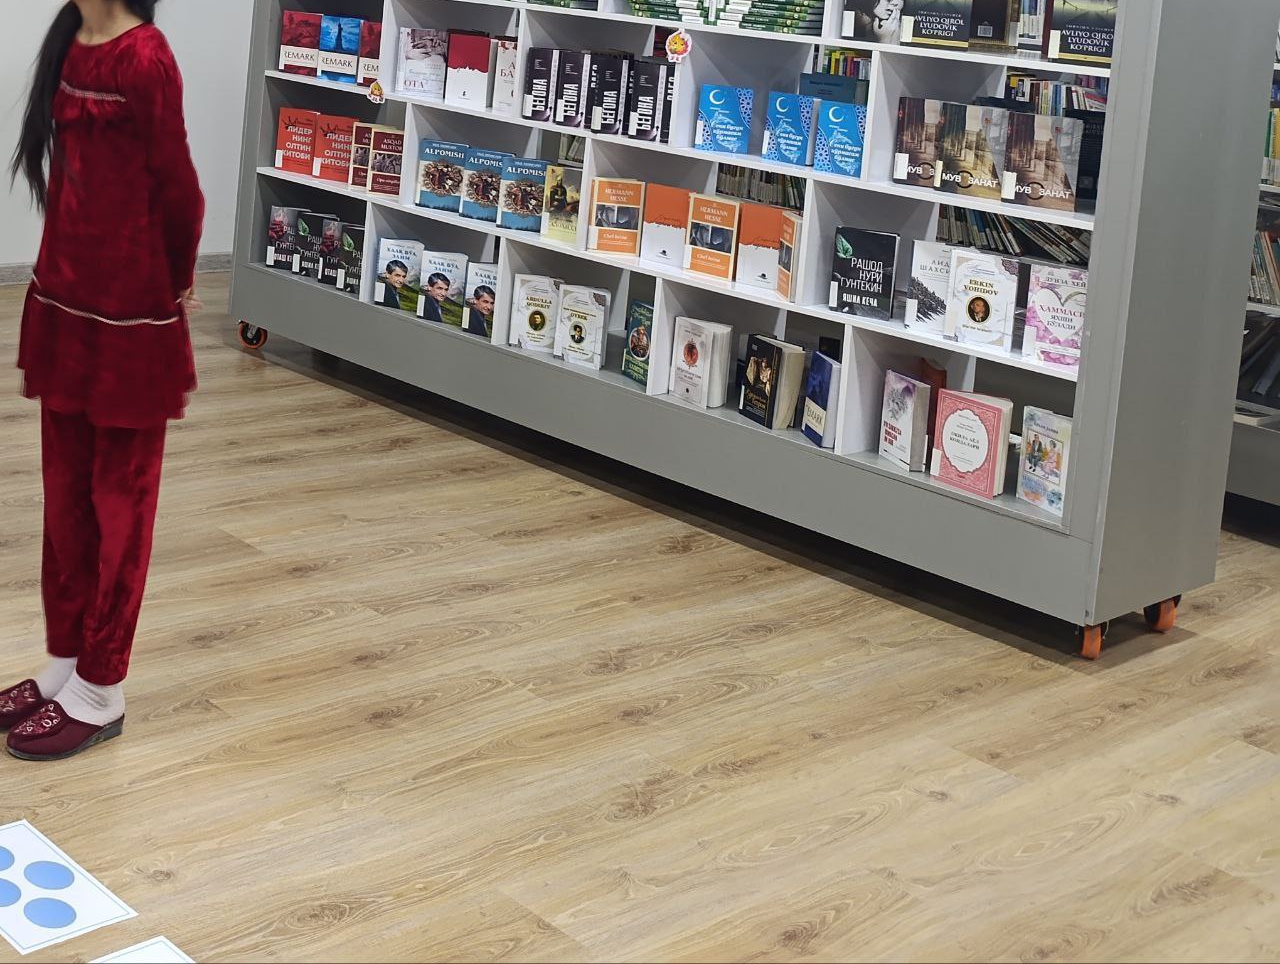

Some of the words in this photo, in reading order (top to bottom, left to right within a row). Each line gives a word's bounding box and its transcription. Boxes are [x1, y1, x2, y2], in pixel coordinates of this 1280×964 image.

[920, 22, 958, 31] LYUDOVIK
[1061, 29, 1090, 38] AVLIYO
[1091, 32, 1114, 40] QIRO
[1067, 36, 1110, 47] LYUDOVIK
[363, 63, 379, 72] REM
[287, 125, 313, 135] ЛИДЕР
[292, 134, 312, 143] НИНГ
[285, 142, 311, 152] ОЛТИН
[281, 149, 311, 161] КИТОБИ
[424, 147, 465, 159] ALPOMISH
[468, 156, 503, 168] ALPOMIS
[605, 187, 634, 196] HERMANN
[700, 206, 729, 216] HERMANN
[704, 214, 722, 223] HESSE
[284, 226, 295, 235] РАШ
[307, 235, 320, 244] РАШ
[276, 241, 295, 250] ГУНТЕ
[301, 249, 320, 259] ГУНТЕК
[851, 257, 883, 273] РАШОД
[859, 270, 883, 283] НУРИ
[840, 277, 883, 294] ГУНТЕКИН
[969, 279, 994, 288] ERKIN
[963, 285, 999, 296] VOHIDOV
[526, 296, 553, 305] ABDULLA
[842, 292, 860, 306] ЯШИЛ
[862, 293, 878, 308] КЕЧА
[1050, 314, 1073, 323] ЯХШИ
